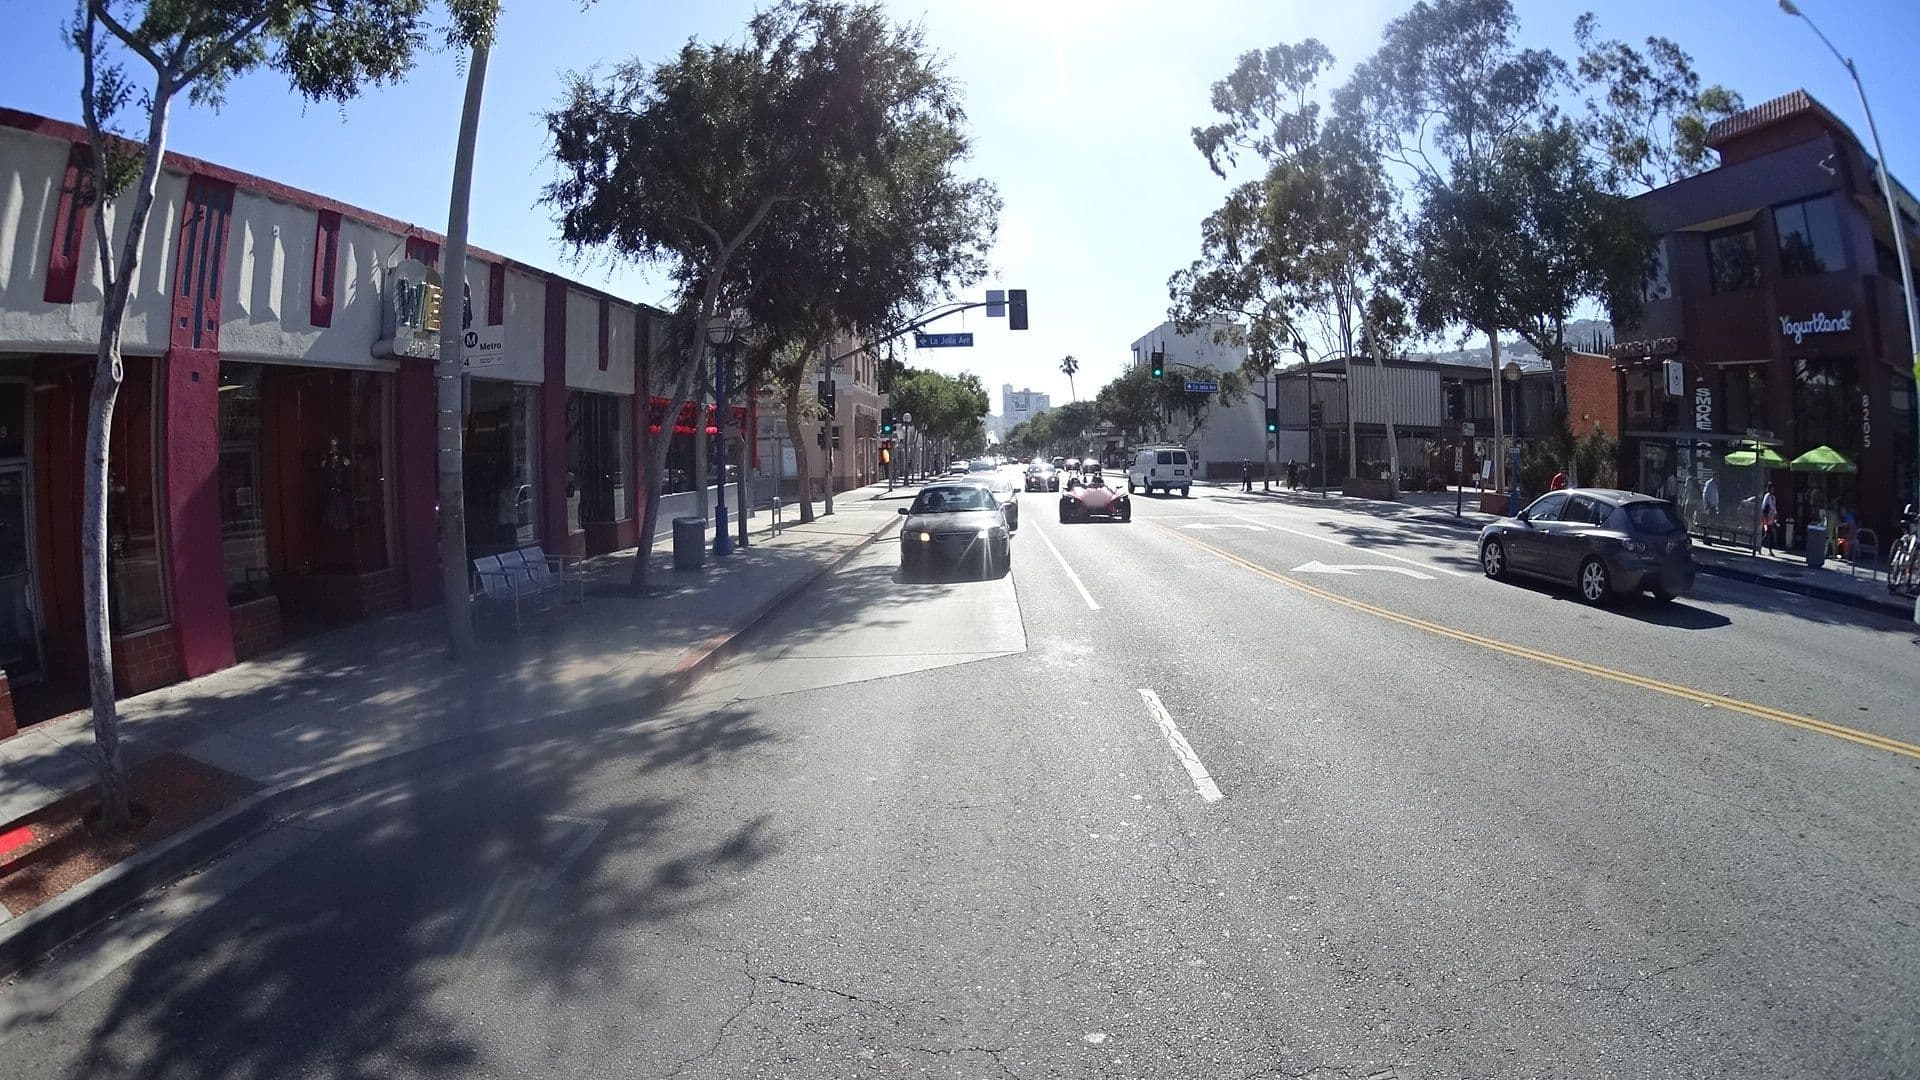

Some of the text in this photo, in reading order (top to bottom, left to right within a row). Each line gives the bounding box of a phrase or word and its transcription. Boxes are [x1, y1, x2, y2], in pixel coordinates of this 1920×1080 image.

[1779, 310, 1851, 344] Yogurtland
[479, 342, 502, 351] Metro
[929, 336, 938, 345] La
[464, 358, 470, 367] 4
[1696, 388, 1712, 431] SMOKE
[1862, 394, 1871, 448] 8205
